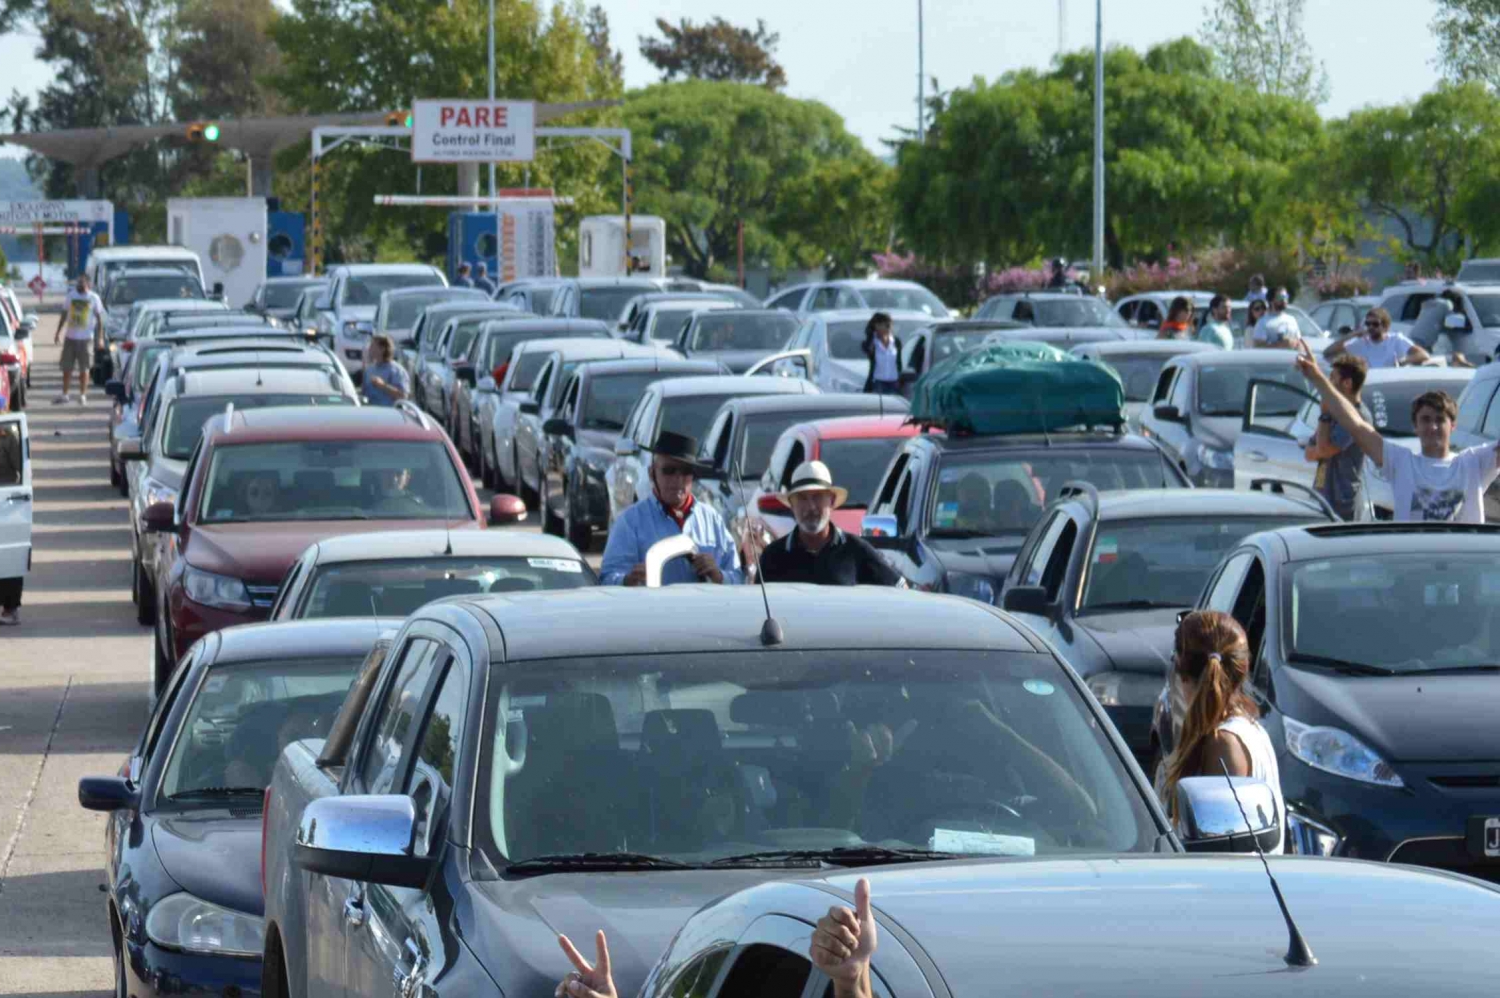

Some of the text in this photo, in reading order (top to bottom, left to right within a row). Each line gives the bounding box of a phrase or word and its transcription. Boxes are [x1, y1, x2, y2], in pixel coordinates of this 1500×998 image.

[440, 106, 508, 128] PARE
[432, 133, 516, 146] Control Final
